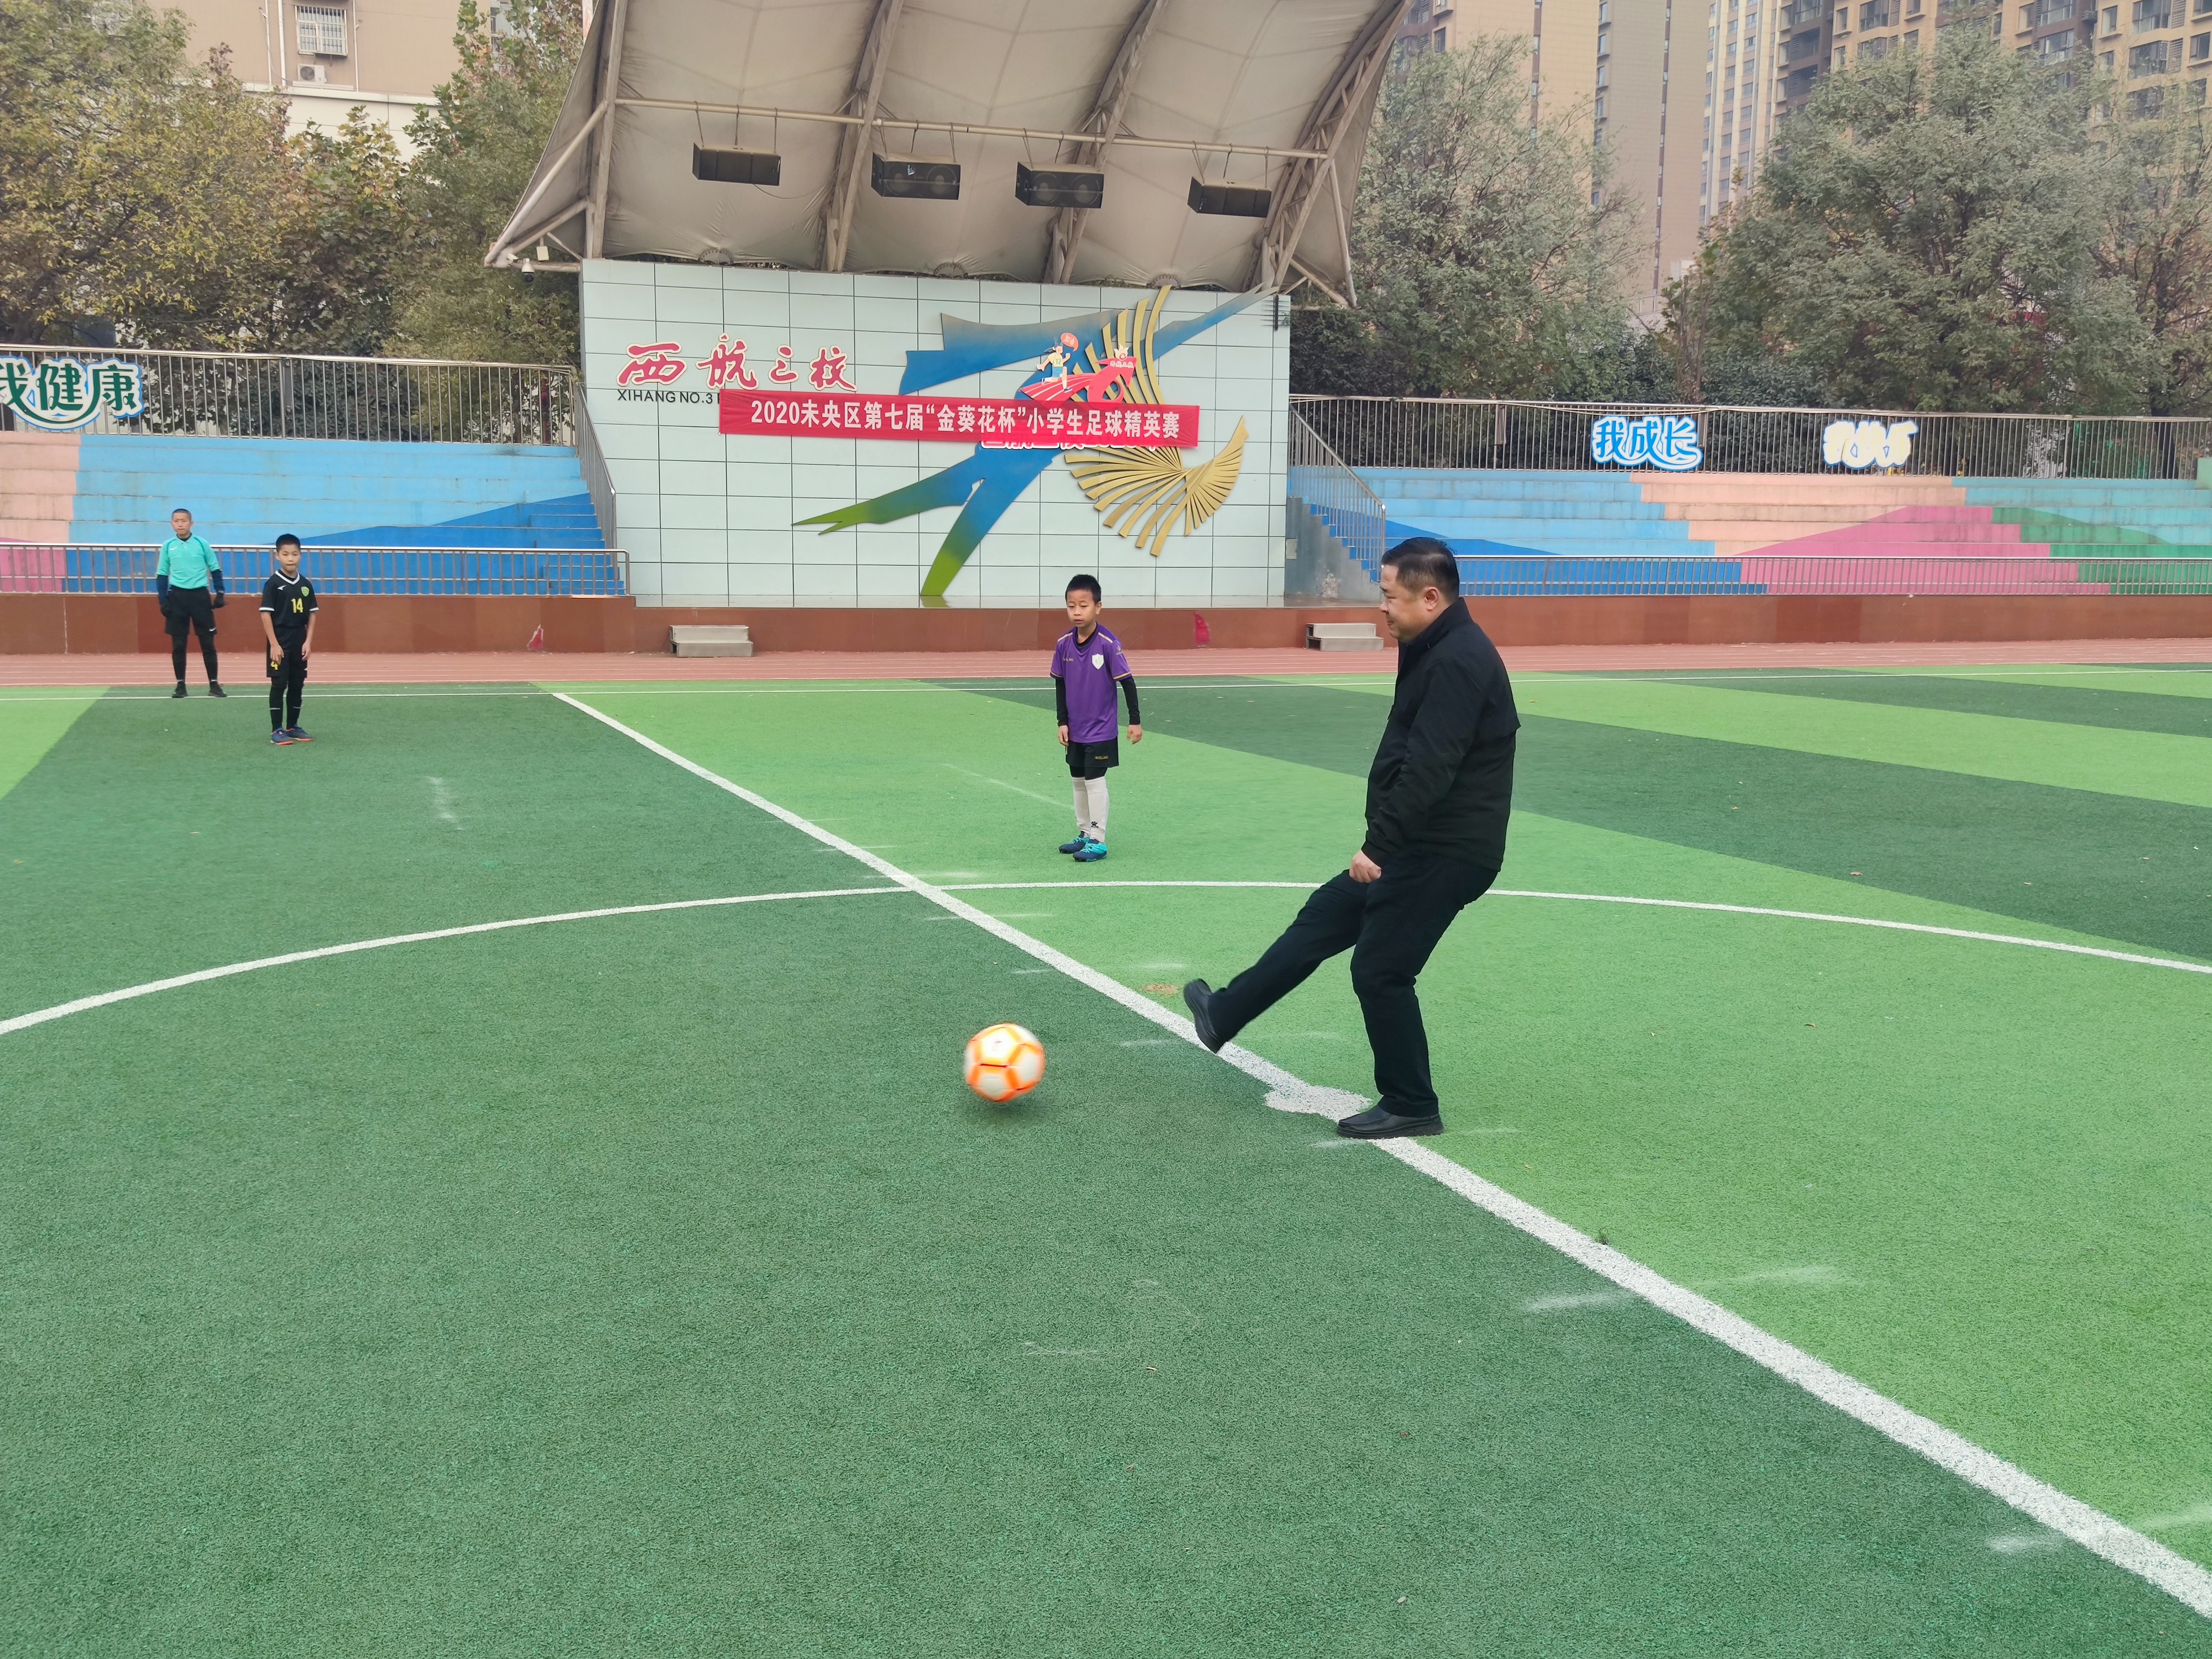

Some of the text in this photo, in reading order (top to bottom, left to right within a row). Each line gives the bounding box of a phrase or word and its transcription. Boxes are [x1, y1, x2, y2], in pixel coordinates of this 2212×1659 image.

[617, 389, 676, 403] XIHANG
[680, 391, 713, 404] NO.3
[1595, 420, 1697, 466] 我成长
[291, 598, 304, 613] 14
